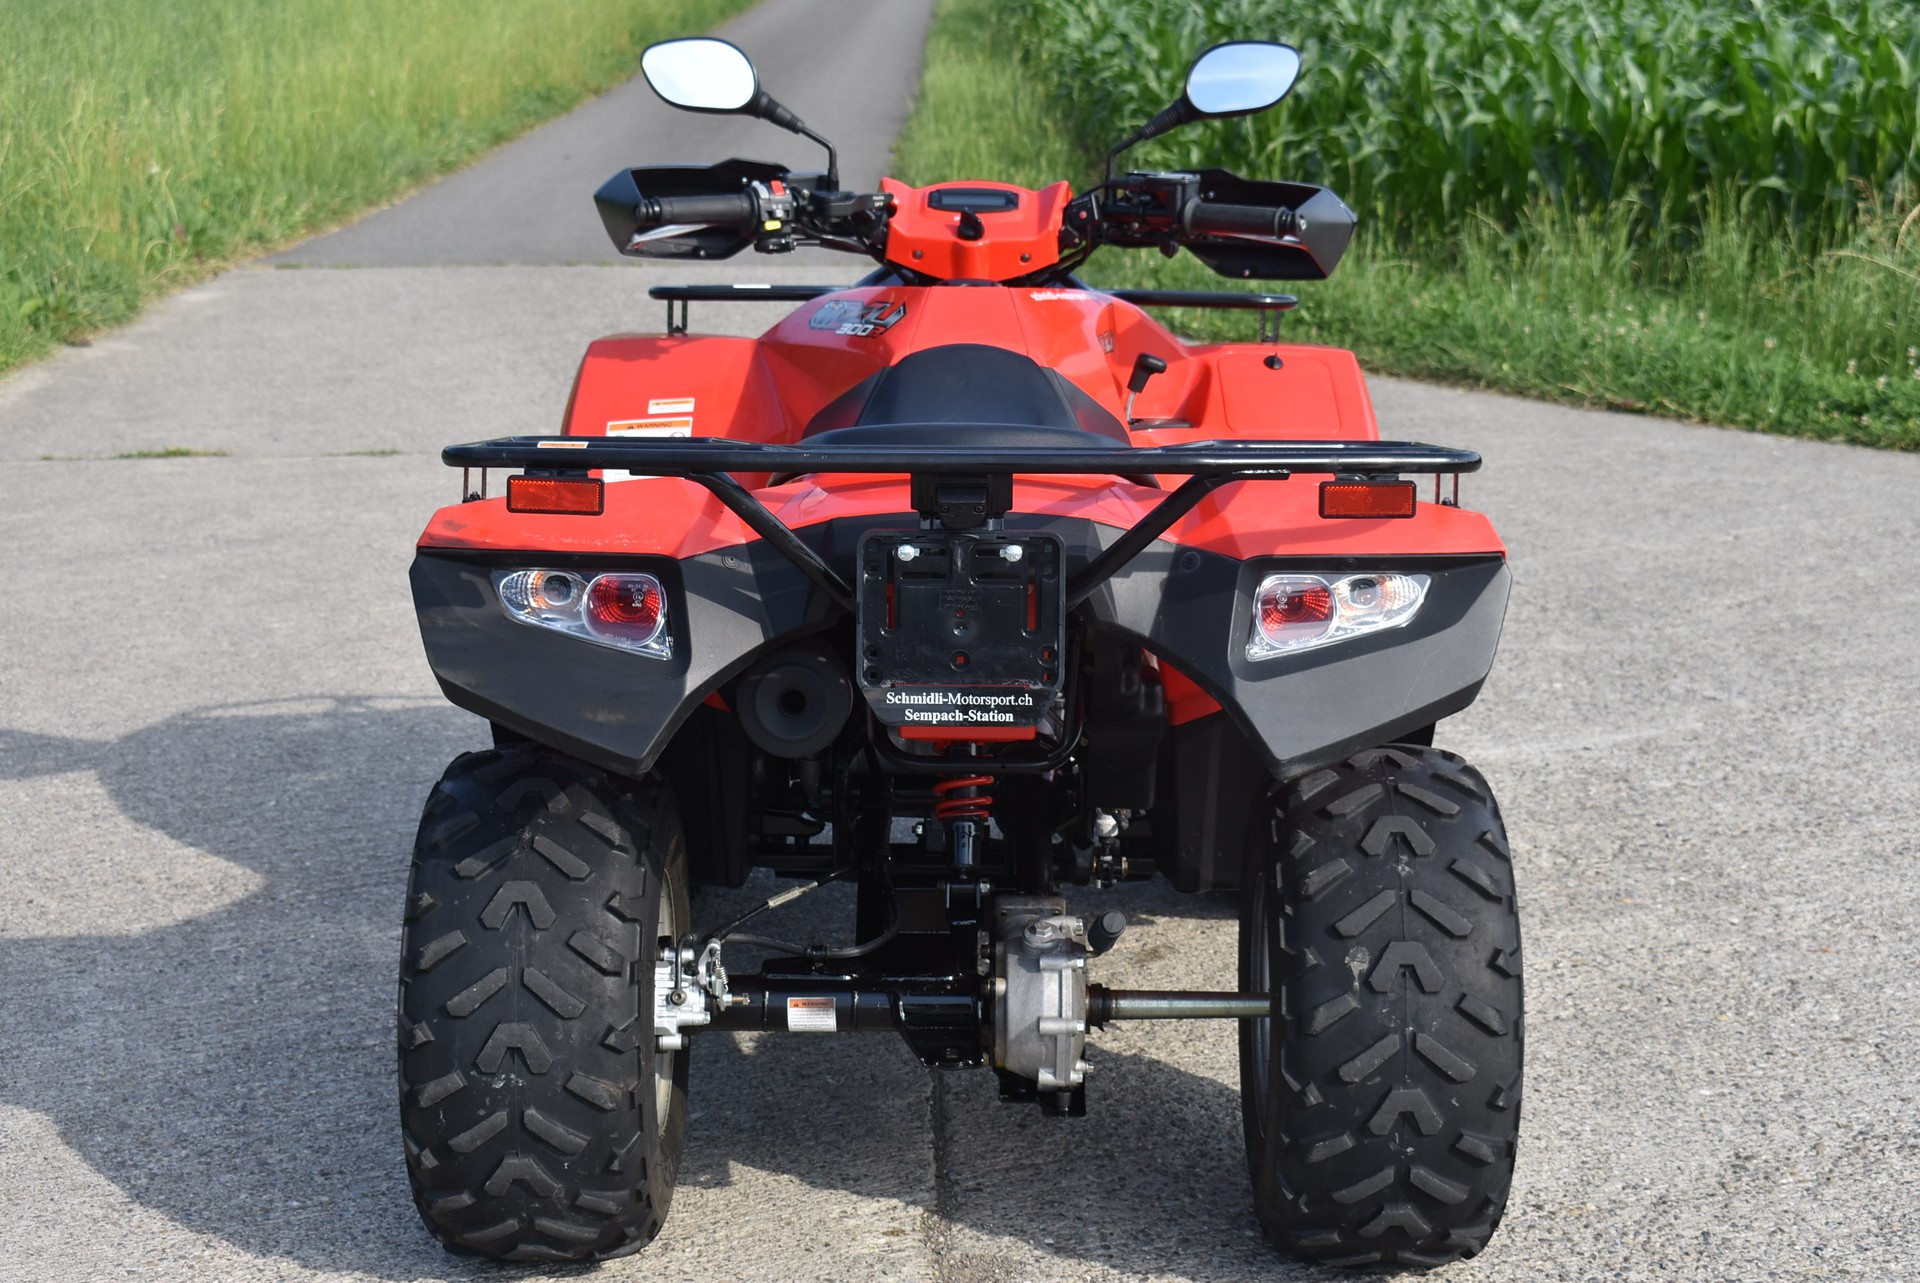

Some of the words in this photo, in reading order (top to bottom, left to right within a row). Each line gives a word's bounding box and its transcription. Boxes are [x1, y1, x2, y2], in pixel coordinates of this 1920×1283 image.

[636, 421, 672, 429] WARNING
[886, 692, 1033, 707] Schmidli-Motorsport.ch
[904, 709, 1014, 724] Sempach-Station
